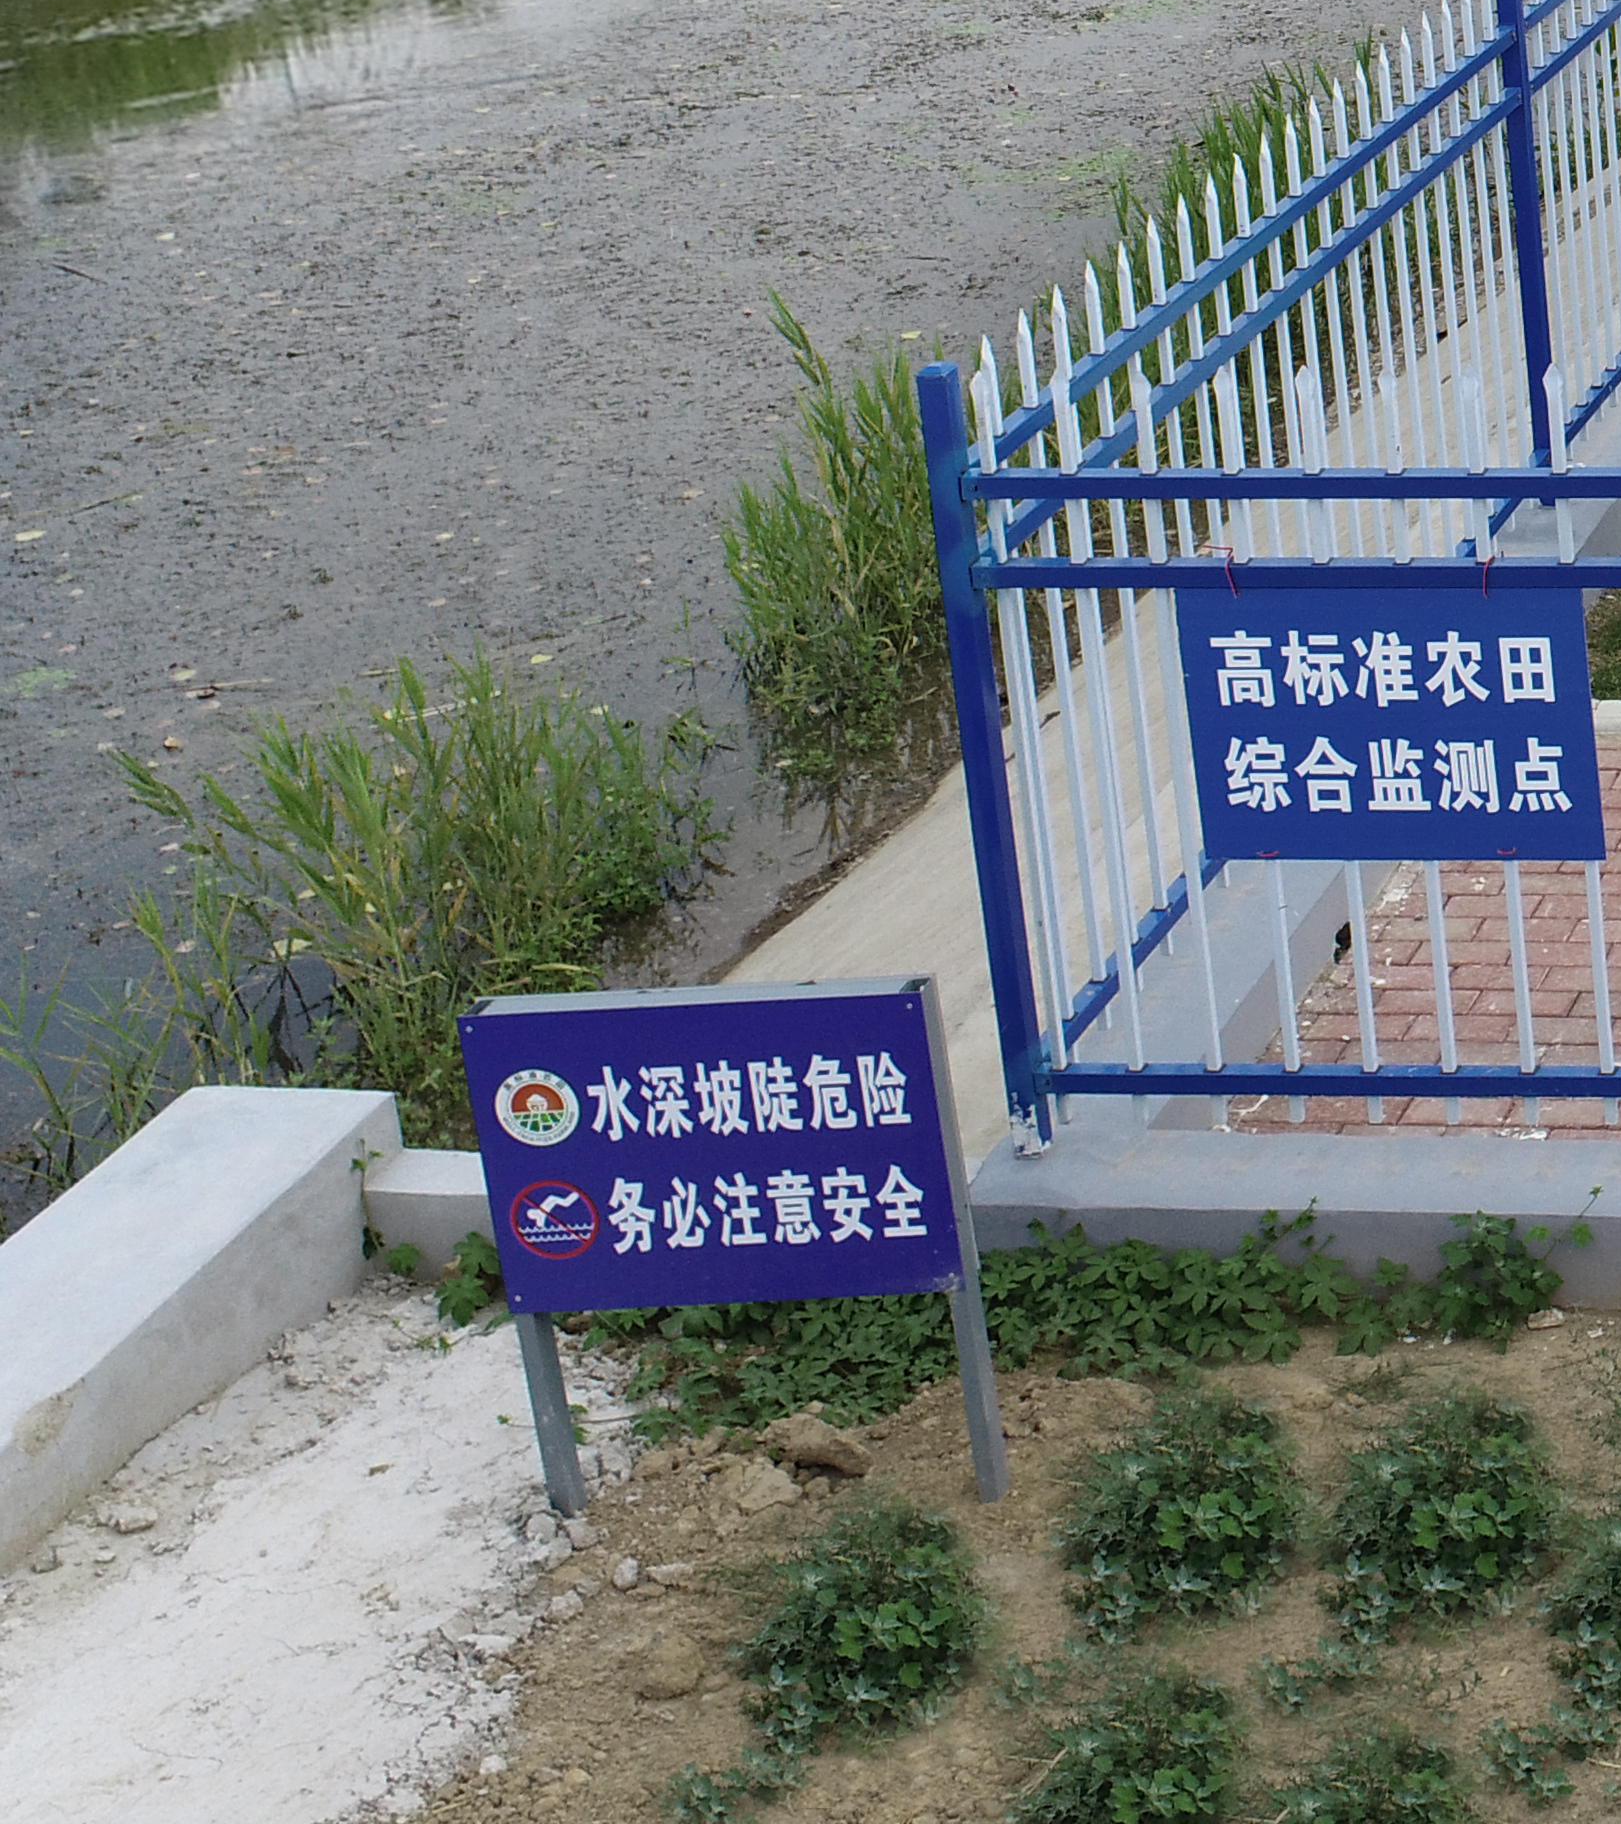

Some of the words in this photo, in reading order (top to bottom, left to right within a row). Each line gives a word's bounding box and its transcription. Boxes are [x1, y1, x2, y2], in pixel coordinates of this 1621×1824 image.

[1210, 630, 1557, 708] 高标准农田
[1224, 736, 1573, 814] 综合监测点
[586, 1052, 912, 1143] 水深坡陡危险
[608, 1164, 929, 1255] 务必注意安全
